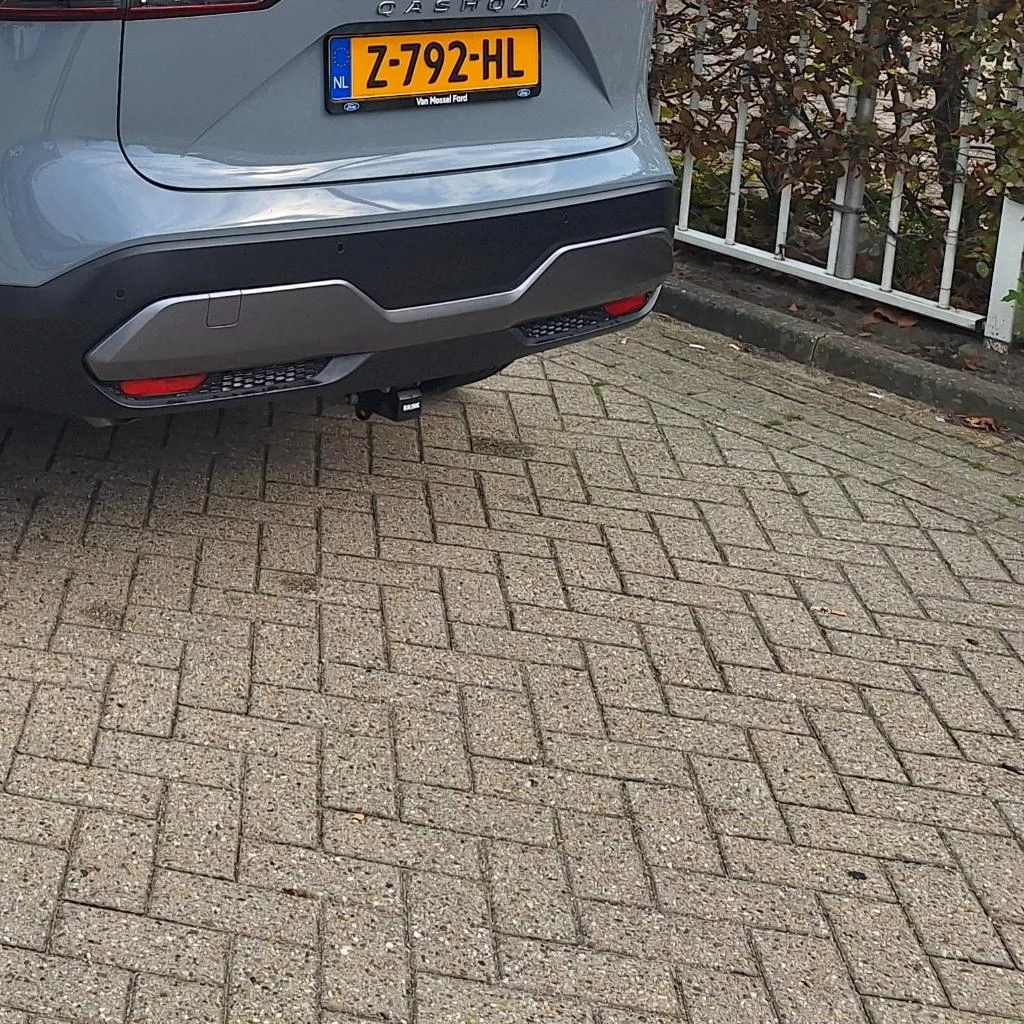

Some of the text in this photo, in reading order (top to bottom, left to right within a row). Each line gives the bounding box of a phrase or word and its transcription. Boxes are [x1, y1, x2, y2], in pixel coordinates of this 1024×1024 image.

[366, 37, 525, 89] Z-792-HL
[333, 76, 349, 89] NL
[416, 94, 468, 106] Van Mossel Ford
